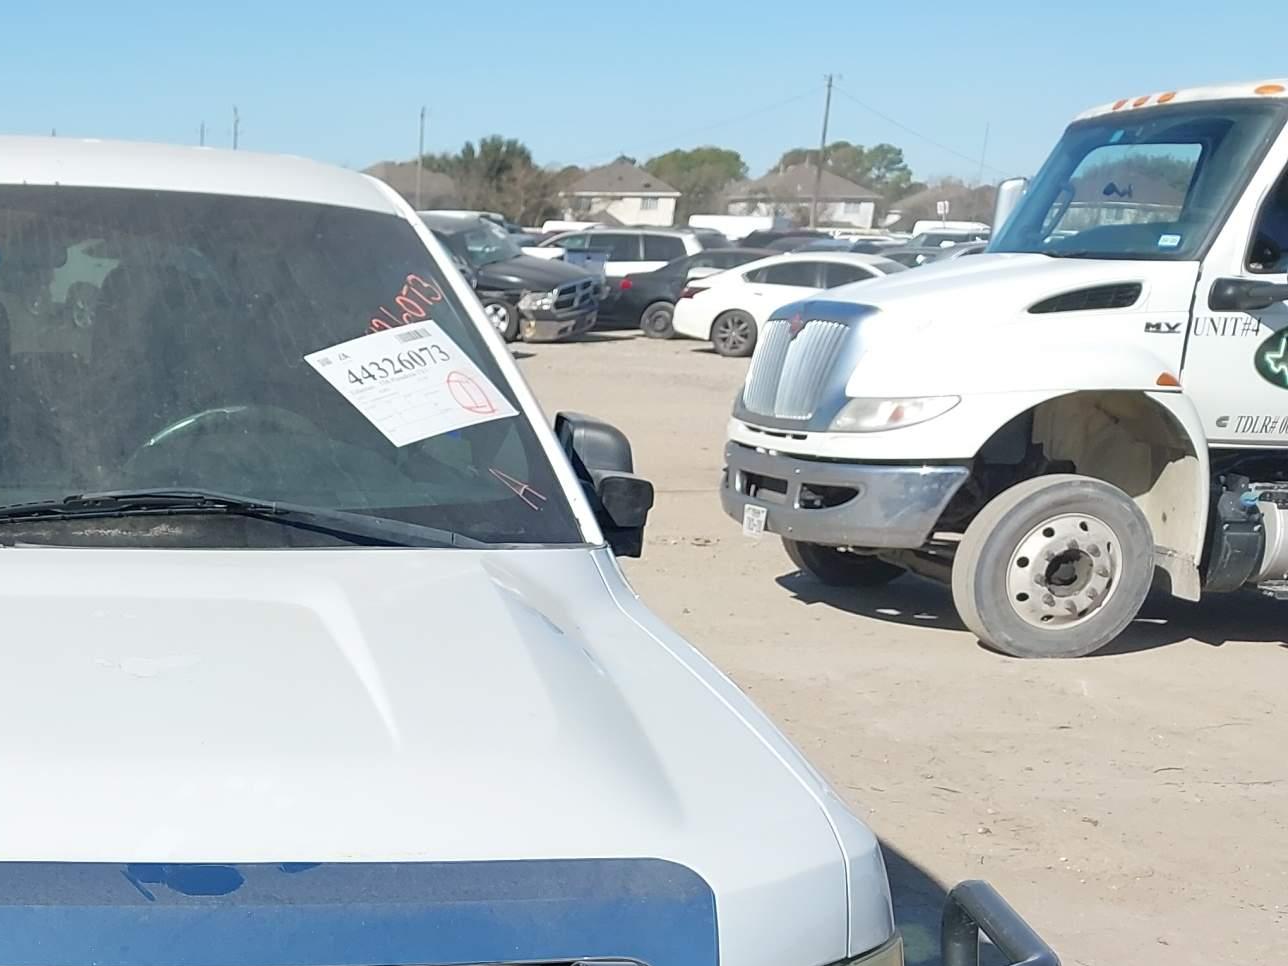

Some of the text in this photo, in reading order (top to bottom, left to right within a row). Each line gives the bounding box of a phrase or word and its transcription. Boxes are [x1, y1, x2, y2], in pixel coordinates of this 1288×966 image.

[1144, 321, 1182, 333] MV
[1193, 316, 1261, 337] UNIT#4
[347, 343, 451, 386] 44326073
[1234, 415, 1279, 434] TDLR#
